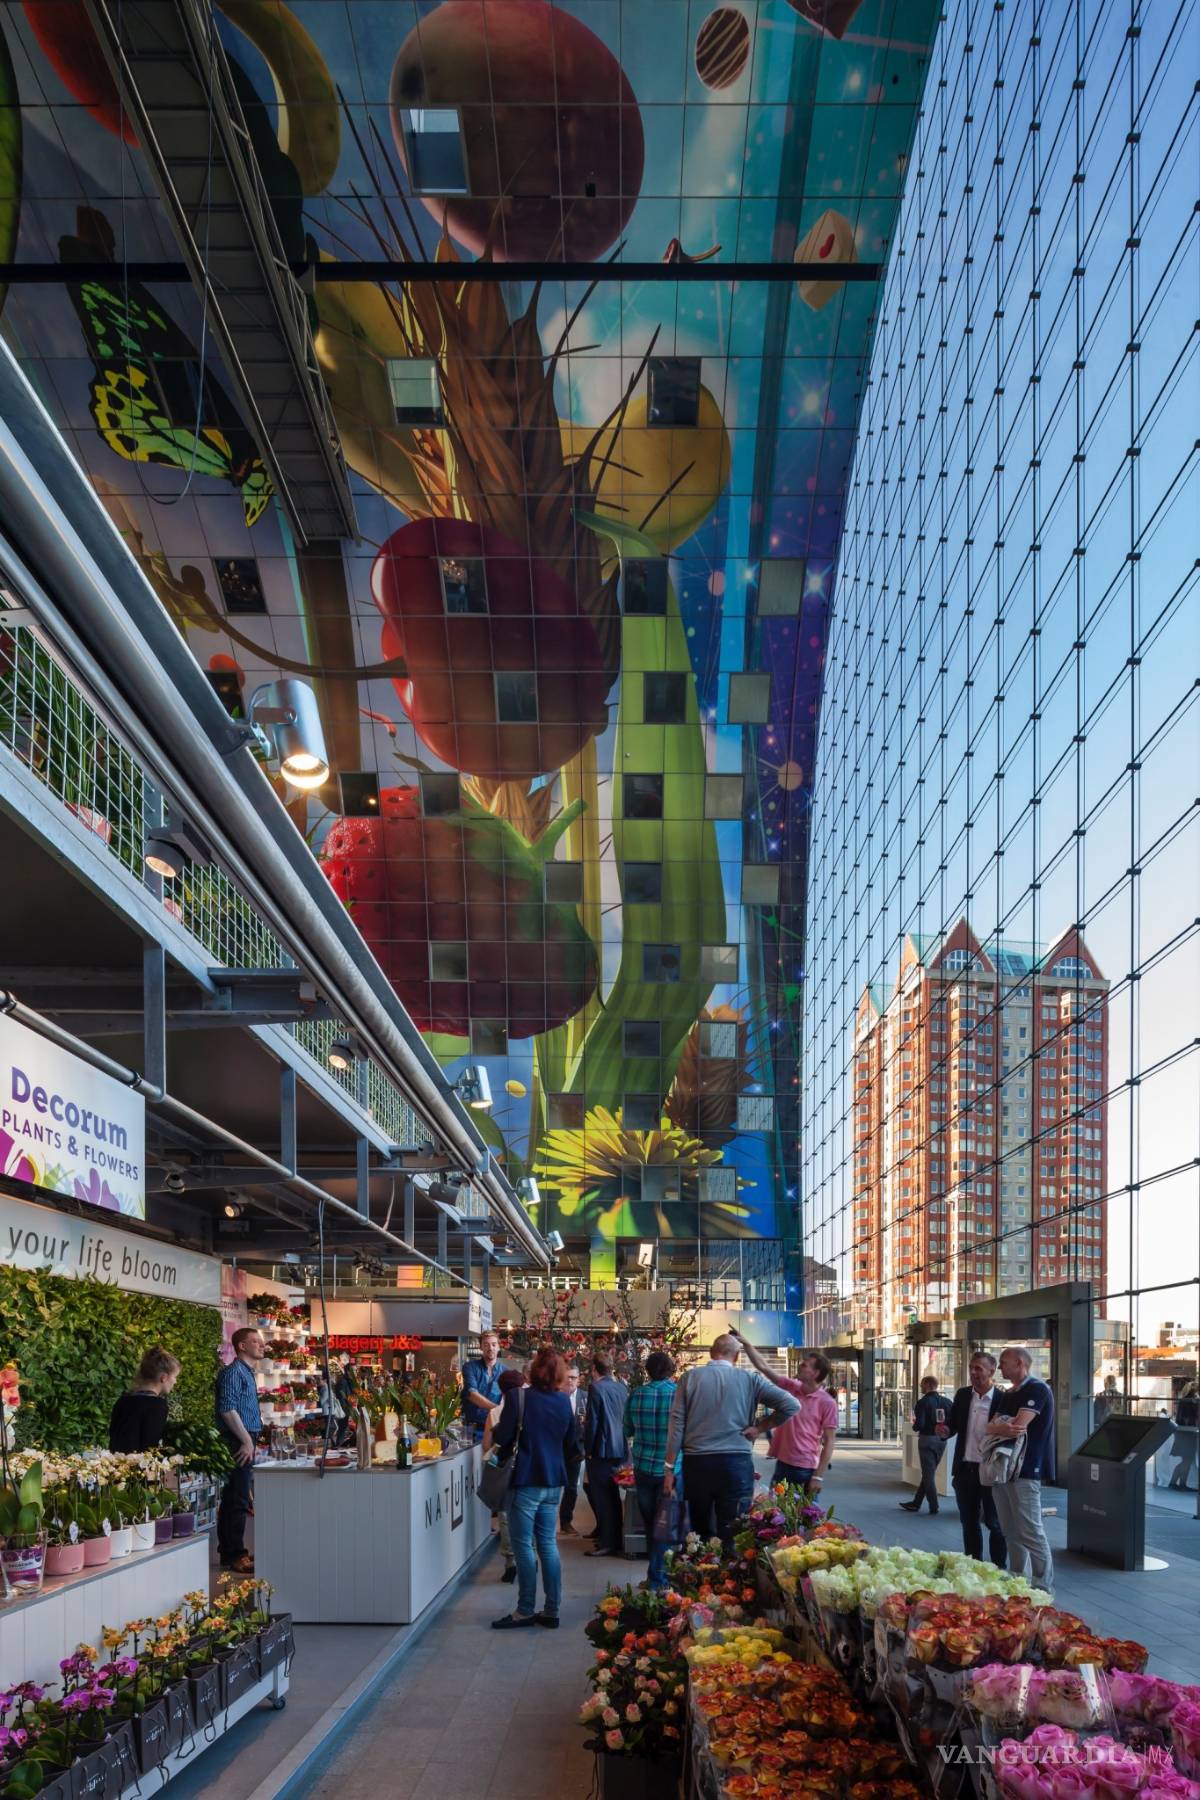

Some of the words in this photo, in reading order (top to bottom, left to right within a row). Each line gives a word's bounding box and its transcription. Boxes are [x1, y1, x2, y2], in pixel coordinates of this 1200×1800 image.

[11, 1066, 128, 1150] Decorum
[2, 1109, 62, 1149] PLANTS
[67, 1135, 79, 1156] &
[84, 1145, 139, 1181] FLOWERS
[6, 1226, 71, 1261] your
[78, 1235, 112, 1274] life
[121, 1246, 177, 1285] bloom
